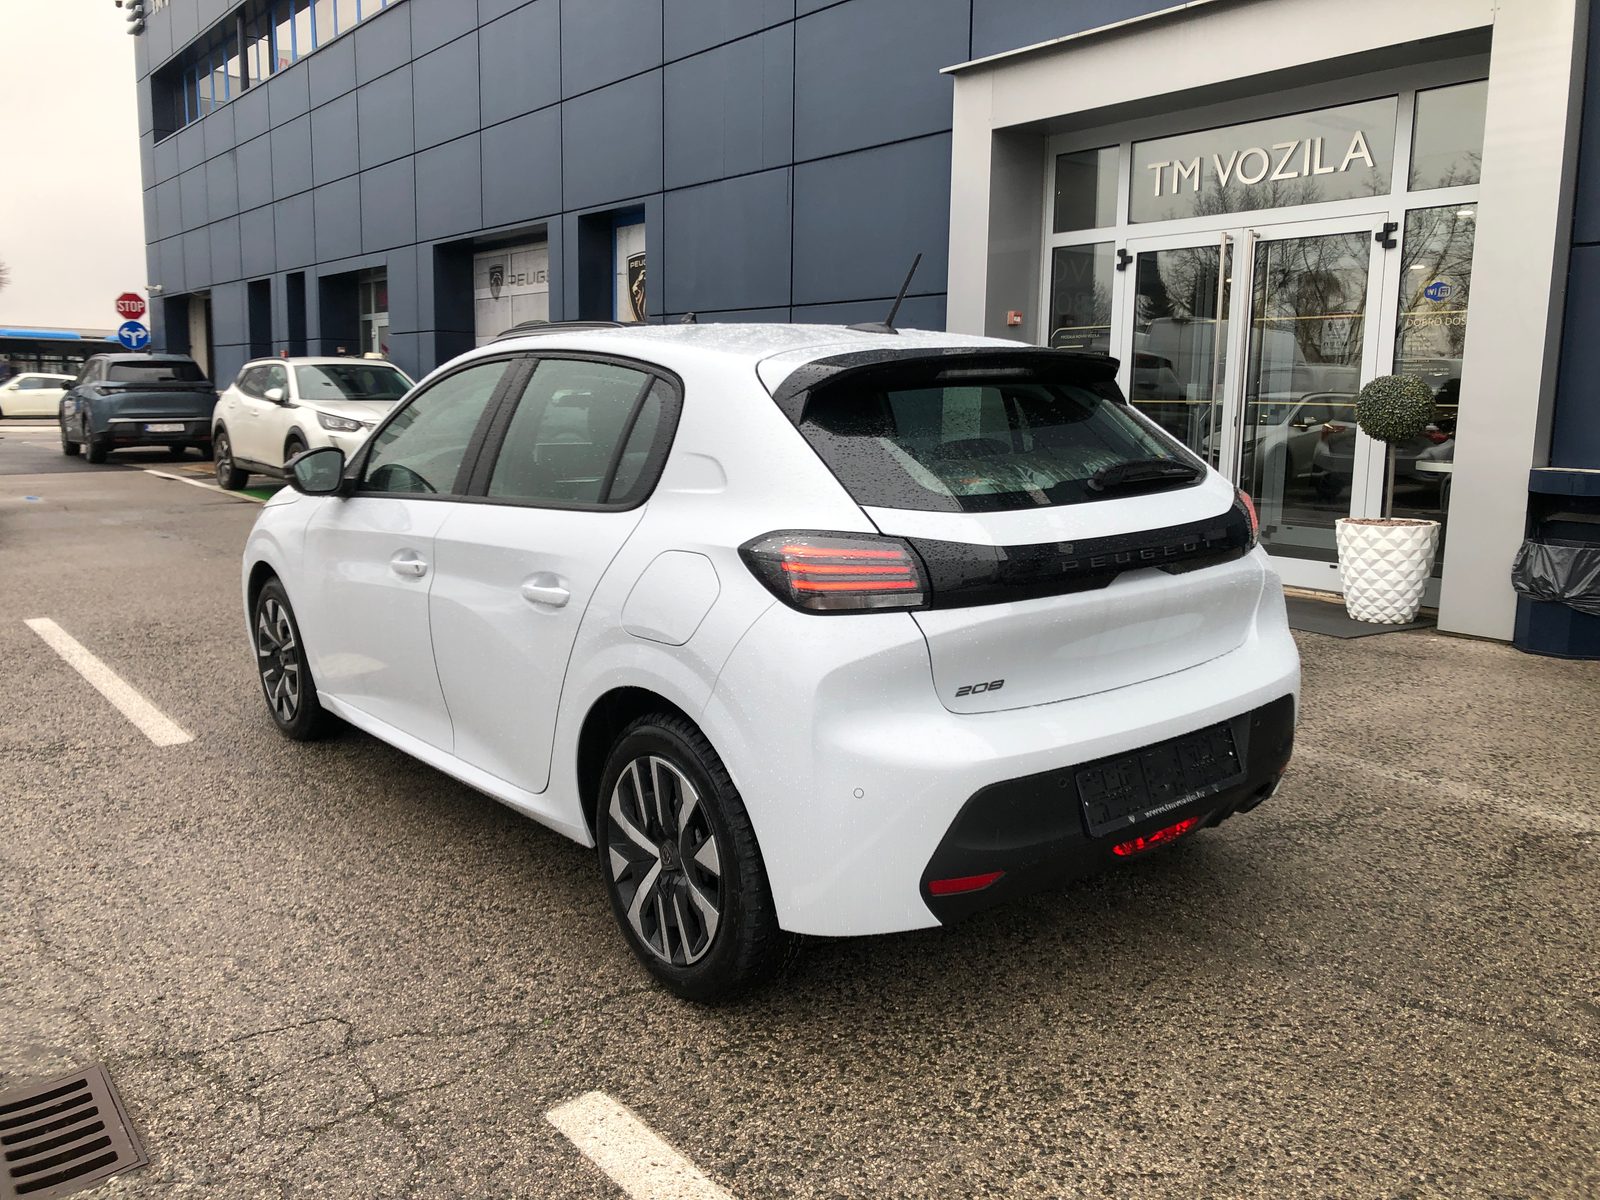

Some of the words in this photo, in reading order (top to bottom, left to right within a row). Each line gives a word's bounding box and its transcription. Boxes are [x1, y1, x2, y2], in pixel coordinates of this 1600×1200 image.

[1148, 156, 1202, 197] TM
[1213, 130, 1375, 188] VOZILA
[507, 269, 549, 287] PEUG
[118, 301, 145, 313] STOP
[1061, 538, 1211, 572] PEUGEOT
[955, 679, 1005, 697] 208
